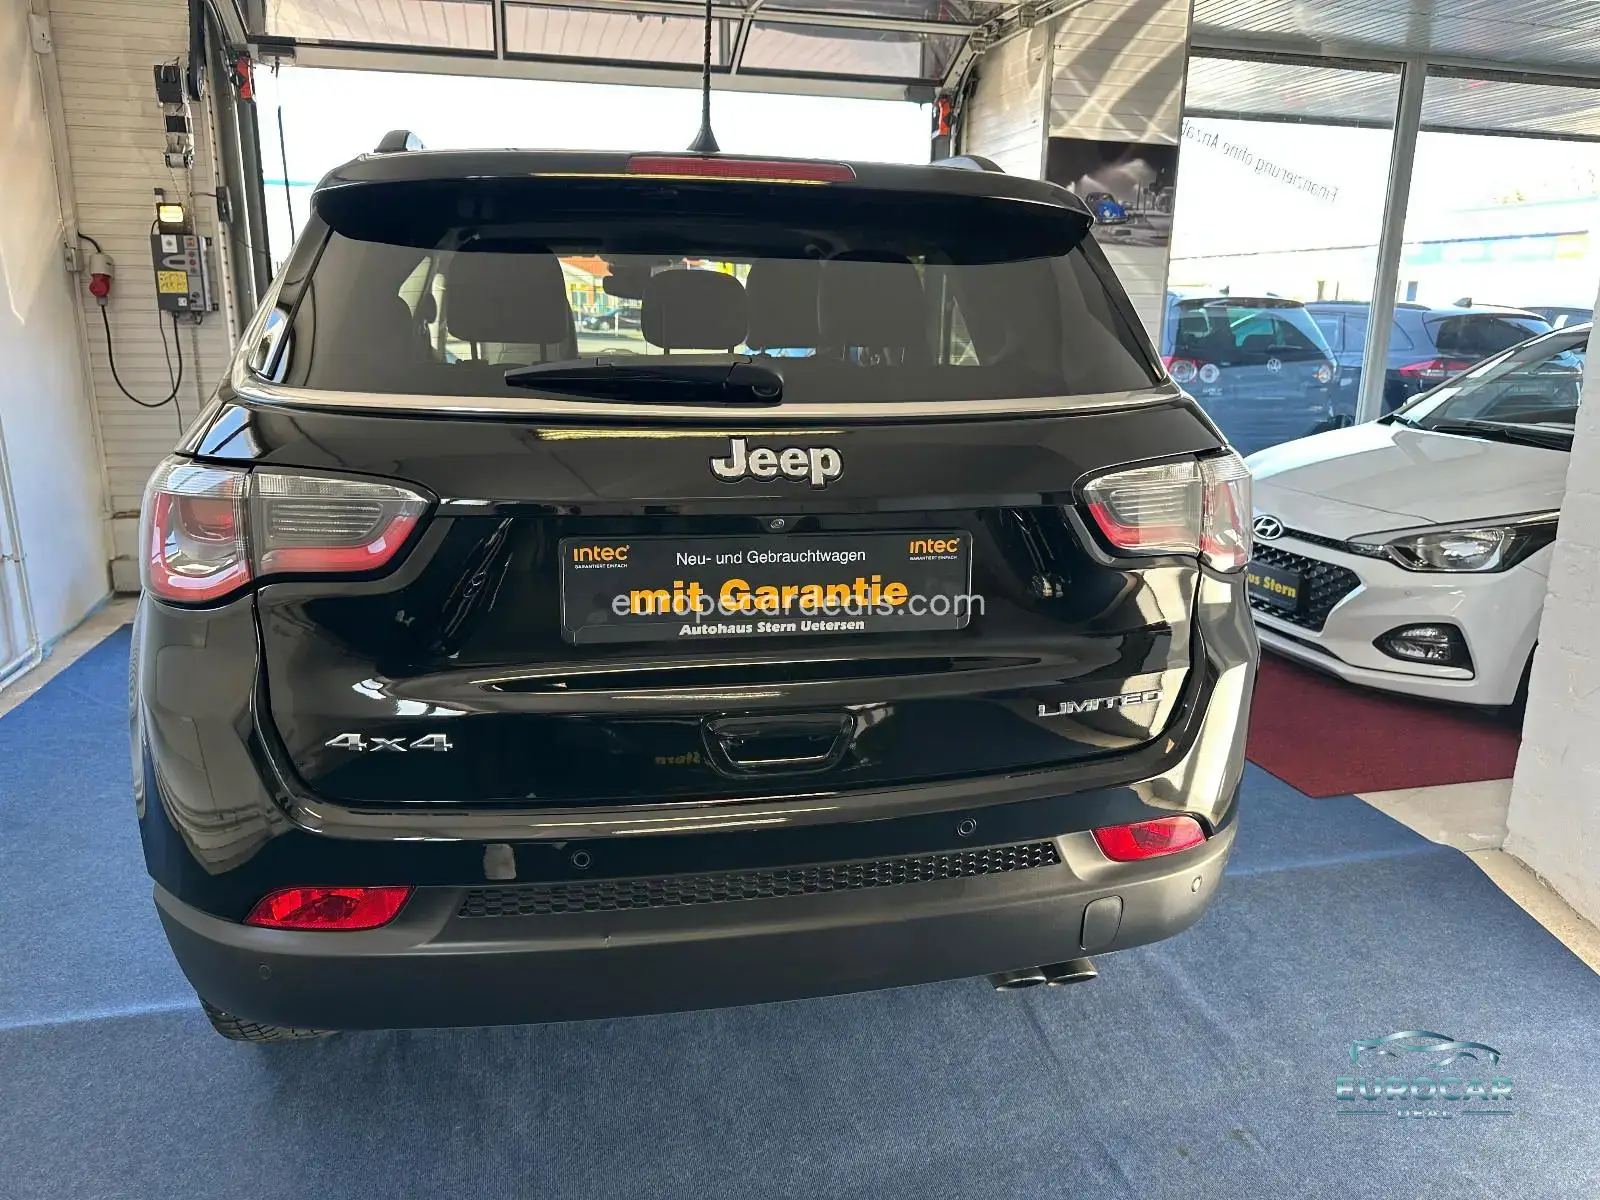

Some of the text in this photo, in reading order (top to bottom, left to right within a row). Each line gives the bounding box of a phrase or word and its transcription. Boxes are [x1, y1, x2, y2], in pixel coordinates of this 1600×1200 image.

[710, 437, 843, 487] Jeep
[573, 545, 629, 562] intec
[909, 538, 959, 554] intec
[676, 549, 866, 566] Neu- und Gebrauchtwagen
[630, 574, 909, 614] mit Garantie
[1263, 576, 1297, 598] Stern
[679, 620, 865, 636] Autohaus Stern Uetersen
[1038, 690, 1162, 717] LIMITED
[324, 733, 453, 752] 4x4
